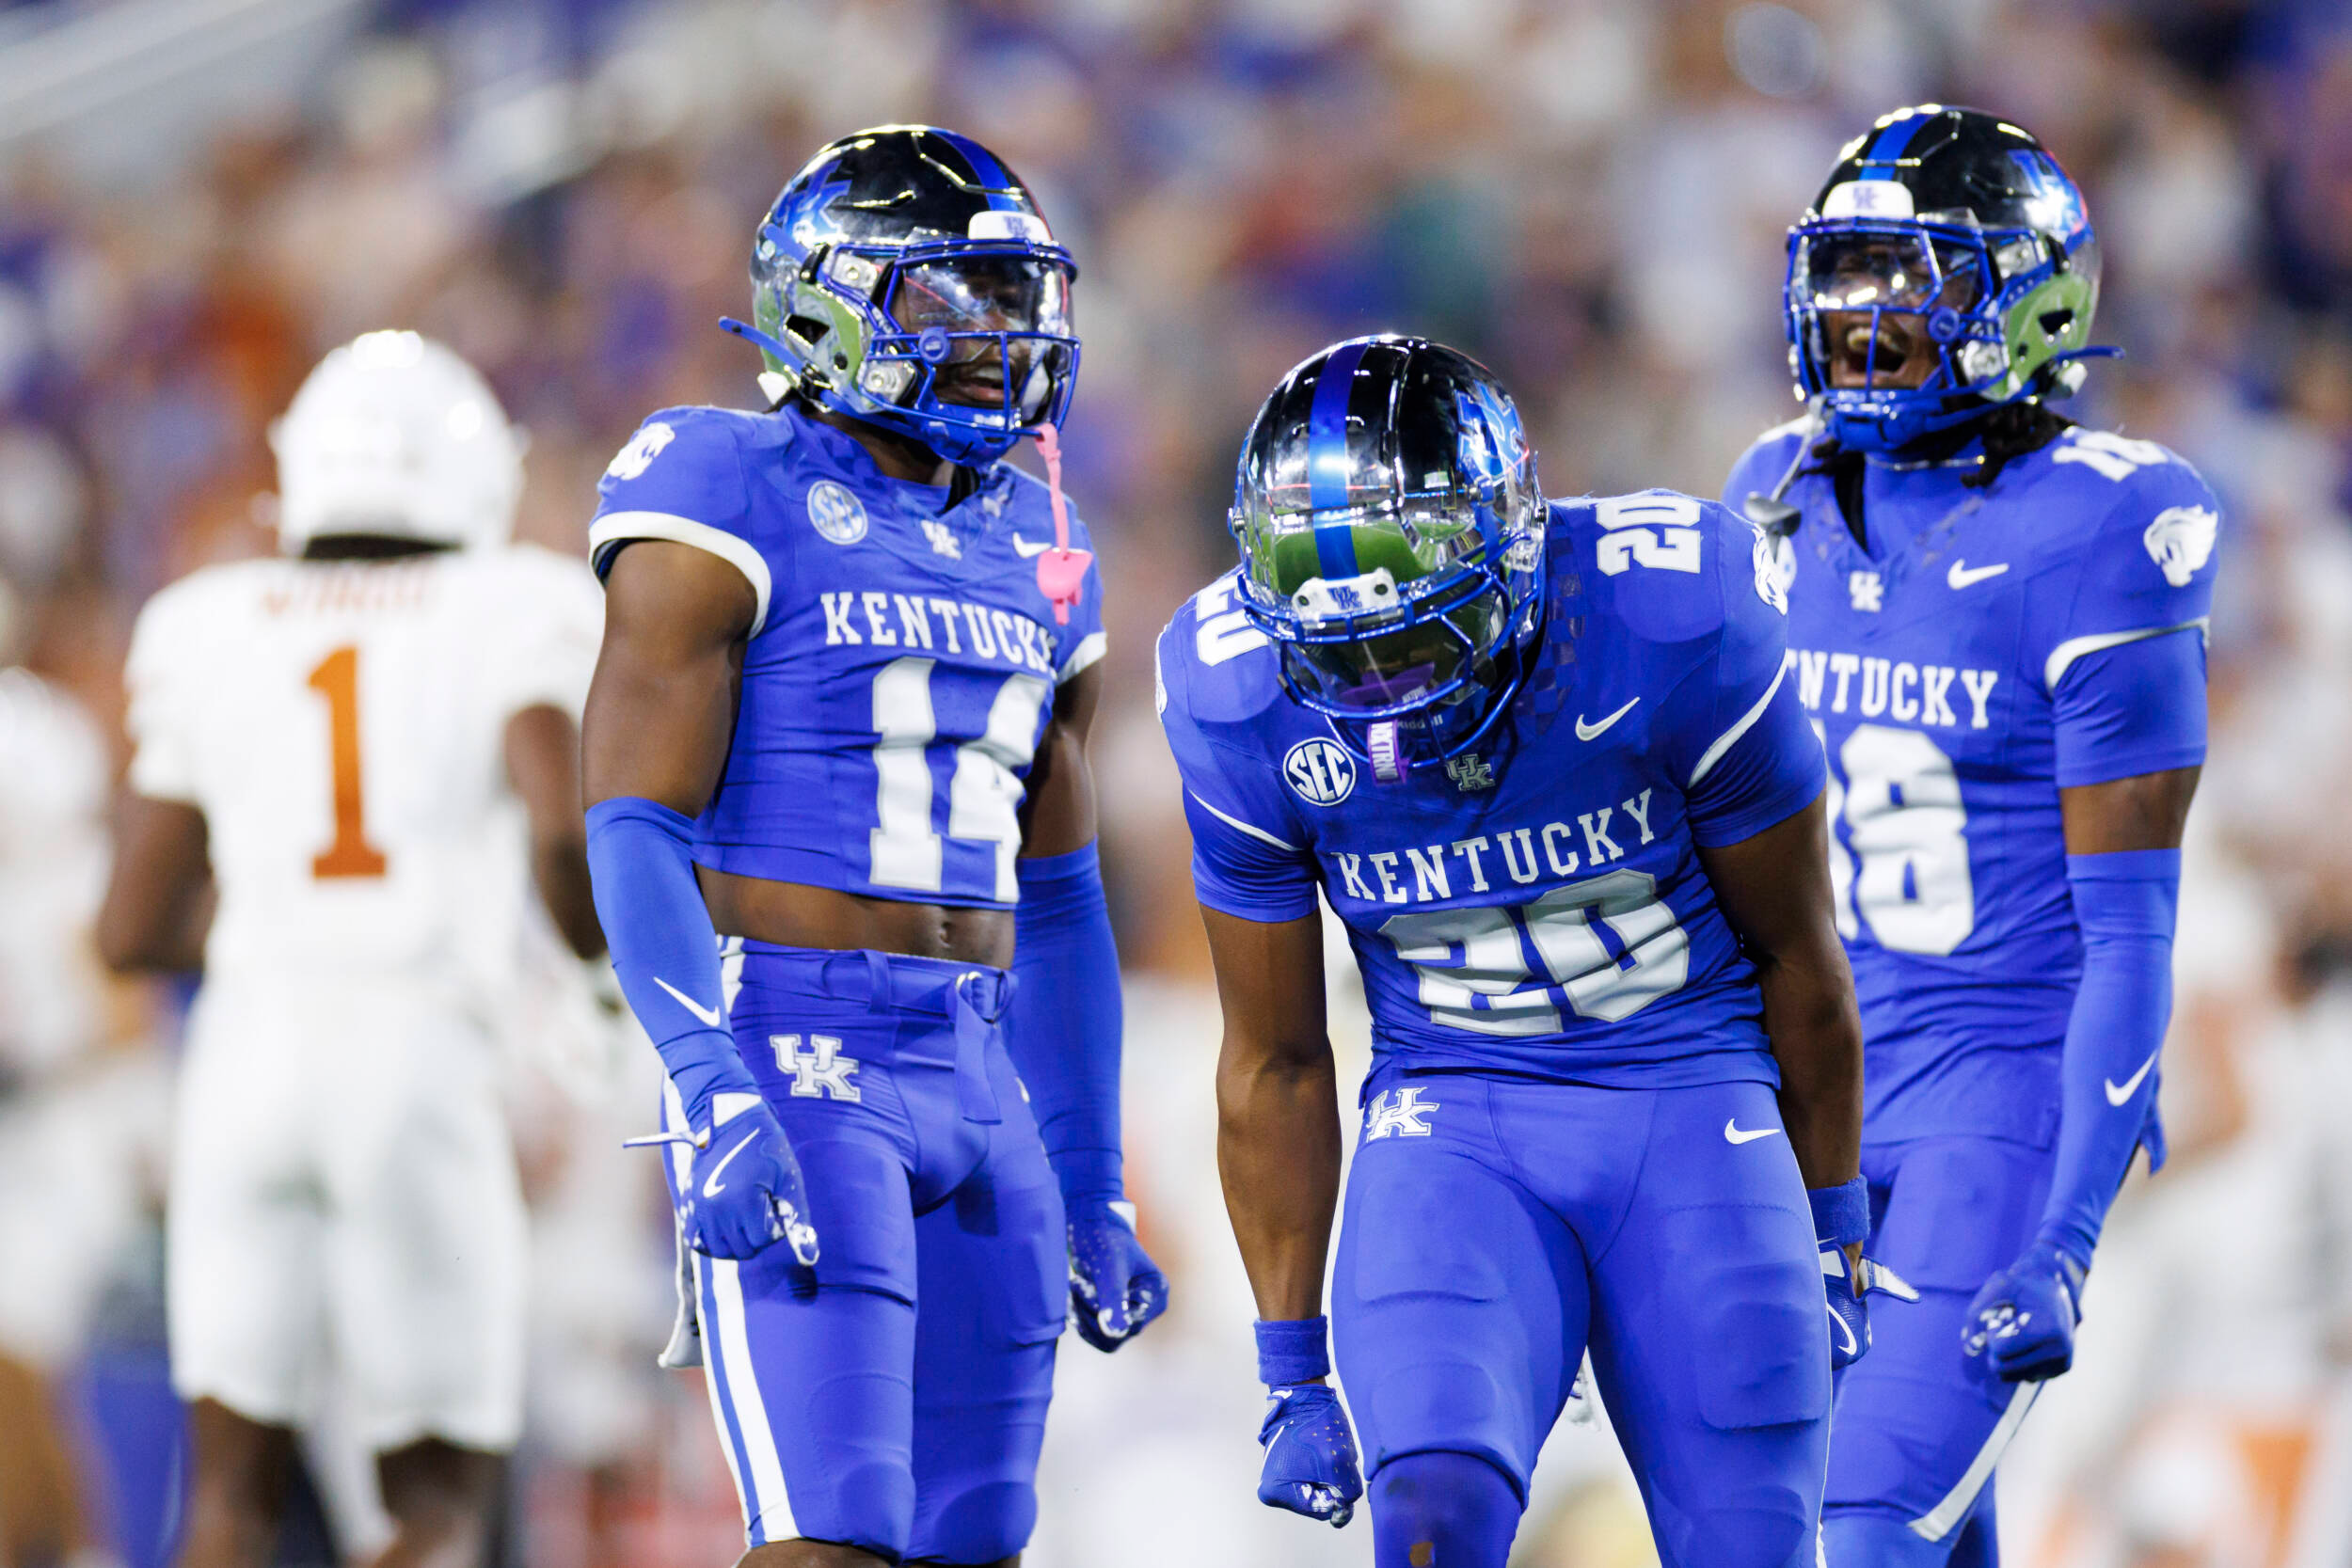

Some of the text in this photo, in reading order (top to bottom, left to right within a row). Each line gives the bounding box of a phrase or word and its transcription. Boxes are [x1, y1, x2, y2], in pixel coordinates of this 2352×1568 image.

[814, 484, 863, 539] SEC
[920, 519, 961, 561] UK
[1597, 497, 1701, 577] 20
[1849, 571, 1883, 612] UK
[1787, 649, 1998, 729] NTUCKY
[305, 644, 388, 879] 1
[868, 657, 1047, 904] 14
[1287, 741, 1351, 802] SEC
[1445, 753, 1496, 791] UK
[1331, 787, 1654, 905] KENTUCKY
[1377, 867, 1690, 1035] 20
[770, 1034, 861, 1102] UK
[1365, 1086, 1439, 1143] UK
